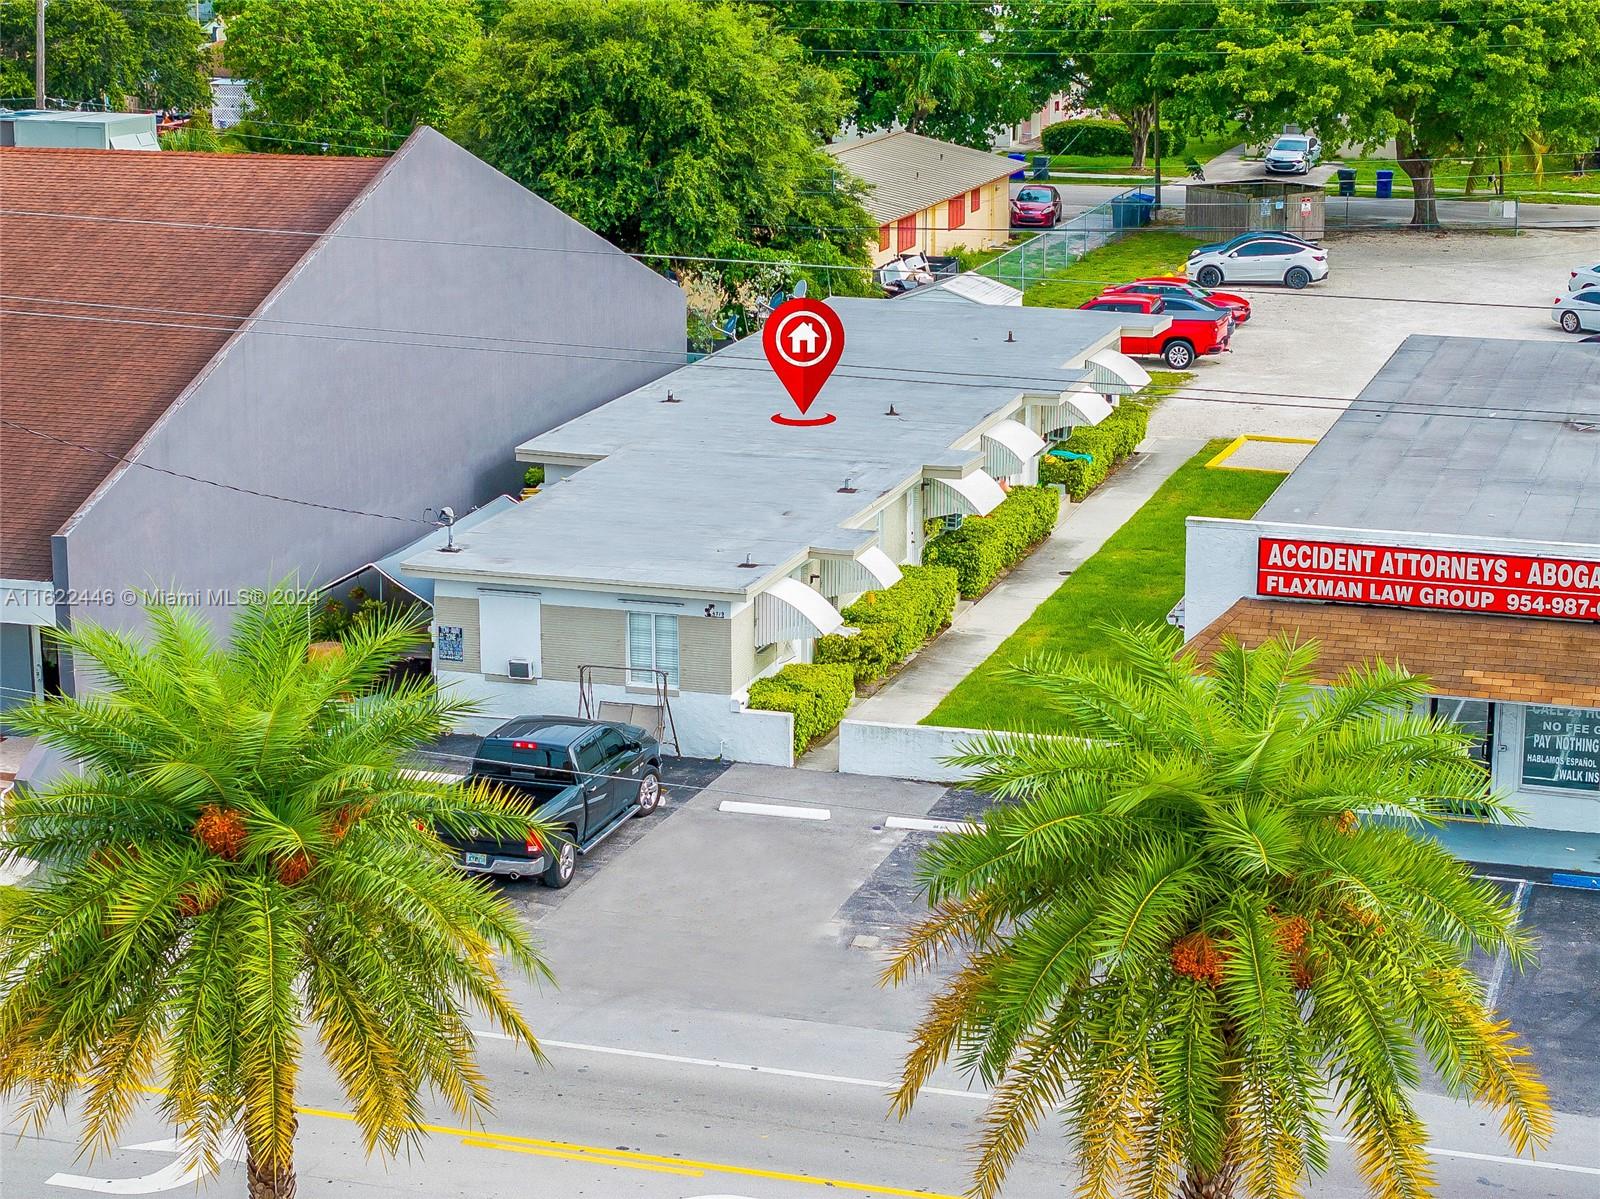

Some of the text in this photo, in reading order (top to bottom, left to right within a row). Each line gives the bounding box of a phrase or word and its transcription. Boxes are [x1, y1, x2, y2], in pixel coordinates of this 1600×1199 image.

[1268, 543, 1600, 590] ACCIDENT ATTORNEYS ABOGA
[1266, 576, 1363, 599] FLAXMAN
[1369, 583, 1414, 602] LAW
[1419, 587, 1495, 608] GROUP
[1543, 721, 1562, 731] NO
[1566, 723, 1589, 734] FEE
[1534, 734, 1600, 753] PAY NOTHING
[1527, 754, 1597, 768] HABLAMOS ESPAÑOL
[1559, 769, 1600, 784] WALK INS
